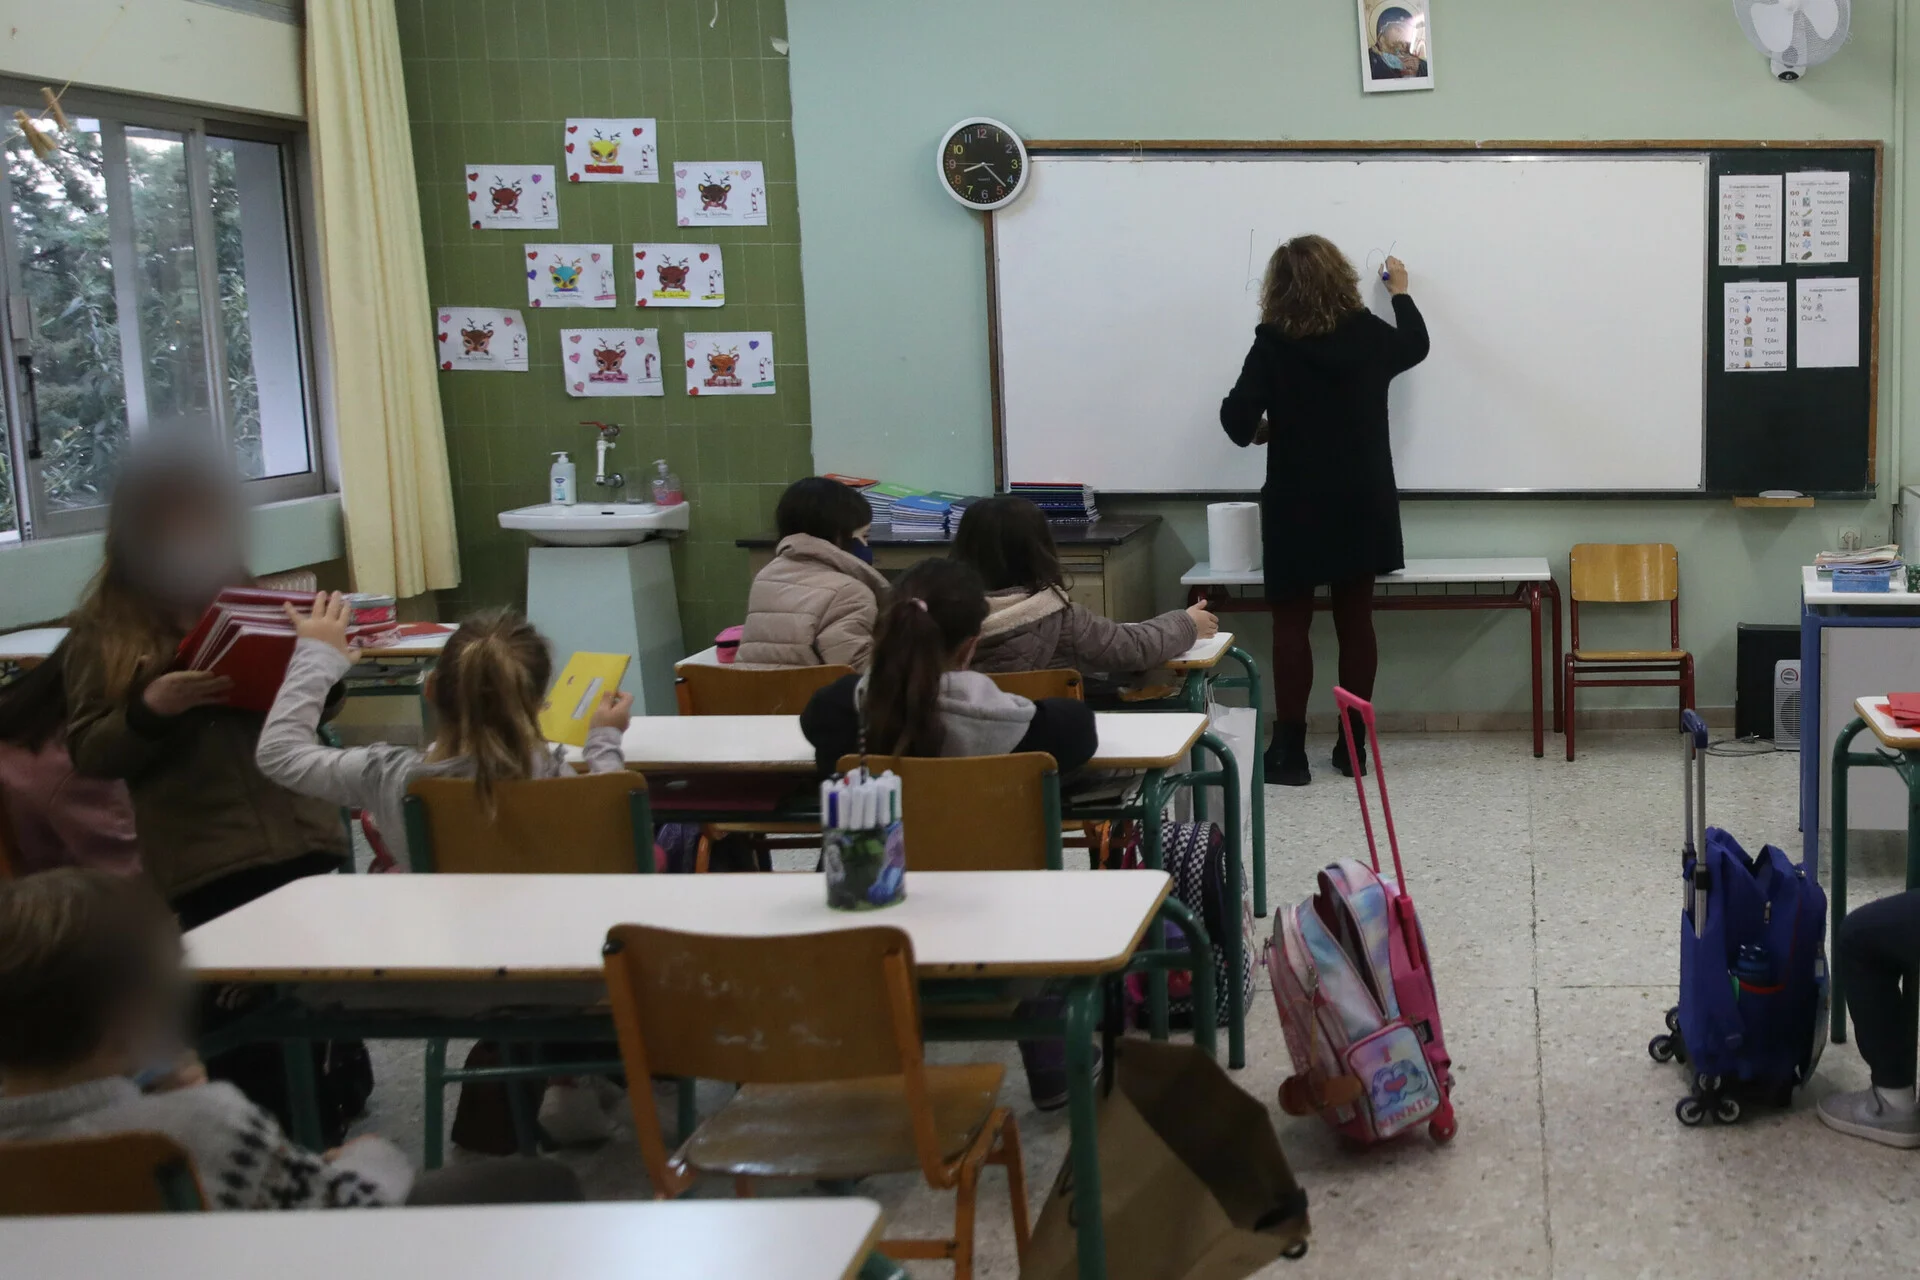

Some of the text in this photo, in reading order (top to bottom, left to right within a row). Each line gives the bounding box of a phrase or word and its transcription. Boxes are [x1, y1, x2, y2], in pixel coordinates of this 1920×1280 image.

[964, 133, 972, 143] 11
[977, 128, 987, 139] 12
[953, 144, 964, 155] 10
[1005, 144, 1013, 154] 2
[949, 160, 956, 169] 9
[1011, 160, 1019, 169] 3
[954, 175, 962, 184] 8
[967, 186, 974, 195] 7
[981, 190, 988, 199] 6
[996, 186, 1004, 195] 5
